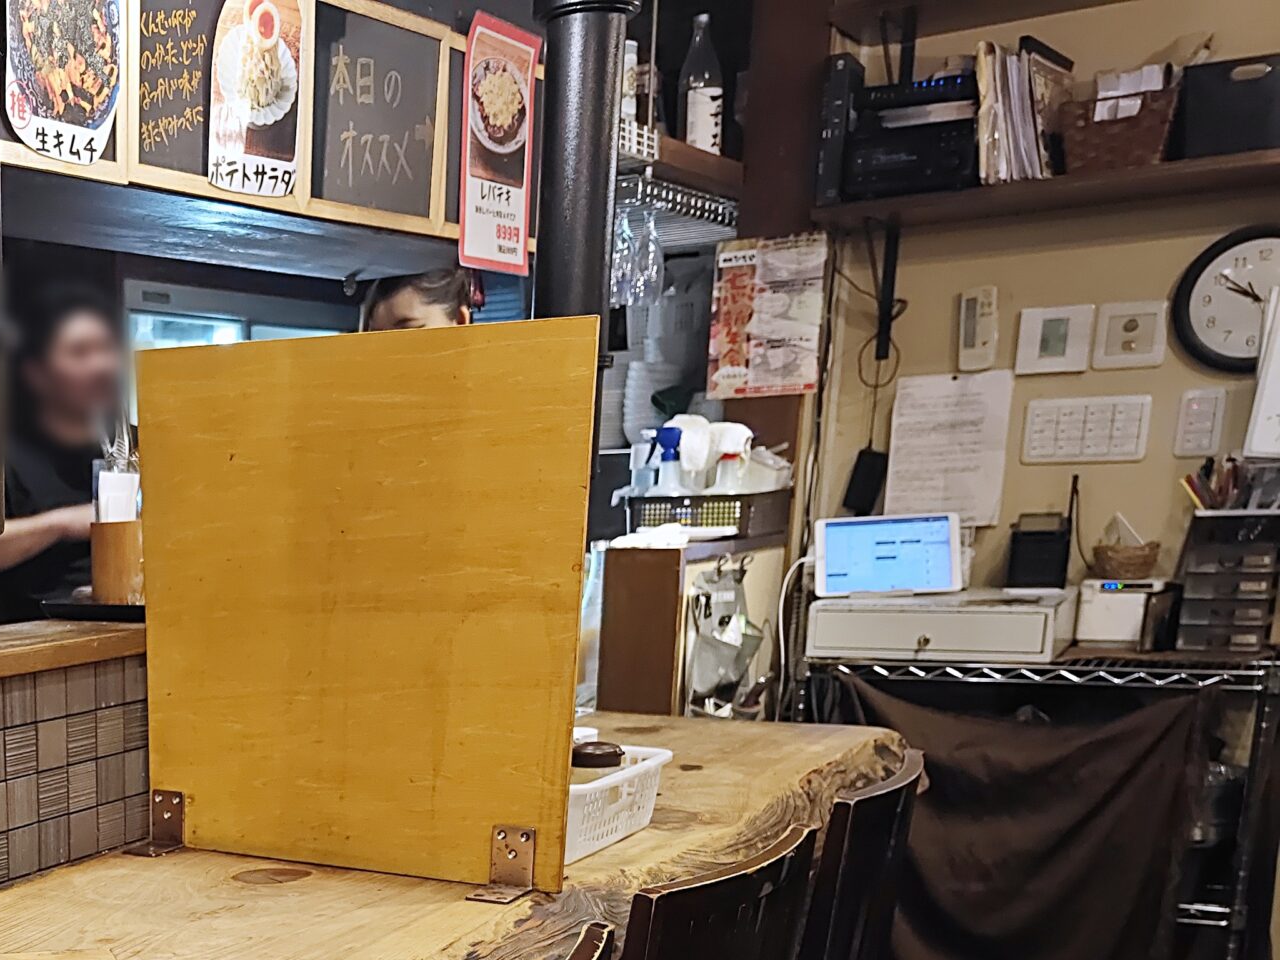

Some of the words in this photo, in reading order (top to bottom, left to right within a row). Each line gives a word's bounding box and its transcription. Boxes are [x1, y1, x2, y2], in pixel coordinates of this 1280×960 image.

[329, 44, 402, 109] 本日の
[9, 89, 27, 121] 推
[35, 126, 97, 163] 生キムチ
[340, 119, 414, 188] オススメ
[210, 155, 296, 195] ポテトサラダ
[480, 181, 511, 207] レバテキ
[1234, 257, 1247, 268] 11
